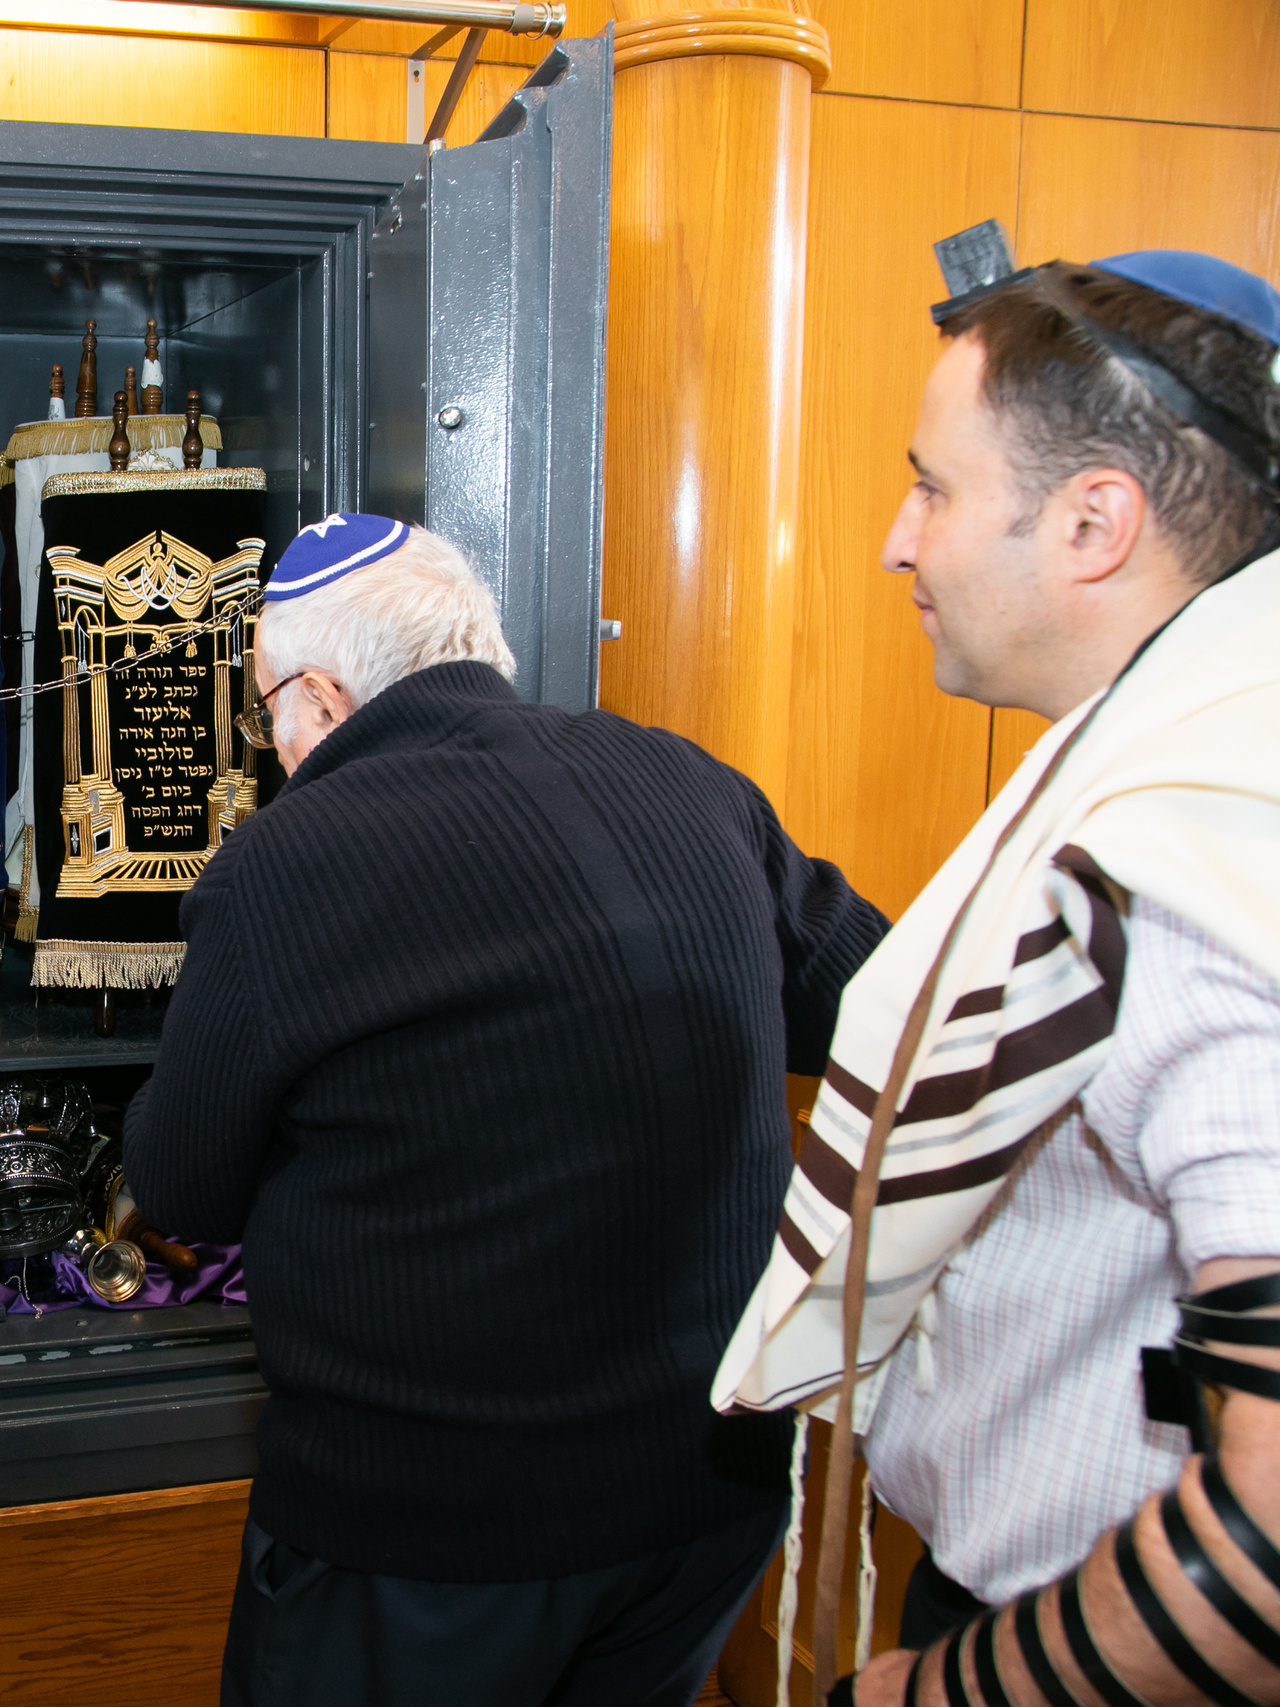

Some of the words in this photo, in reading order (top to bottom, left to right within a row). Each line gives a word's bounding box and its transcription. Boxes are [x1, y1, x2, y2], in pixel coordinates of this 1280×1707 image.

[137, 666, 172, 679] תורה
[179, 666, 206, 678] ספר
[164, 685, 198, 698] נכתב
[134, 701, 191, 722] אליעזר
[119, 727, 154, 740] אירה
[160, 726, 186, 740] חנה
[192, 726, 206, 740] בן
[116, 767, 142, 782] ניסן
[178, 765, 214, 778] נפטר
[162, 785, 192, 797] ביום
[131, 805, 170, 818] הפסח
[177, 804, 202, 816] דחג
